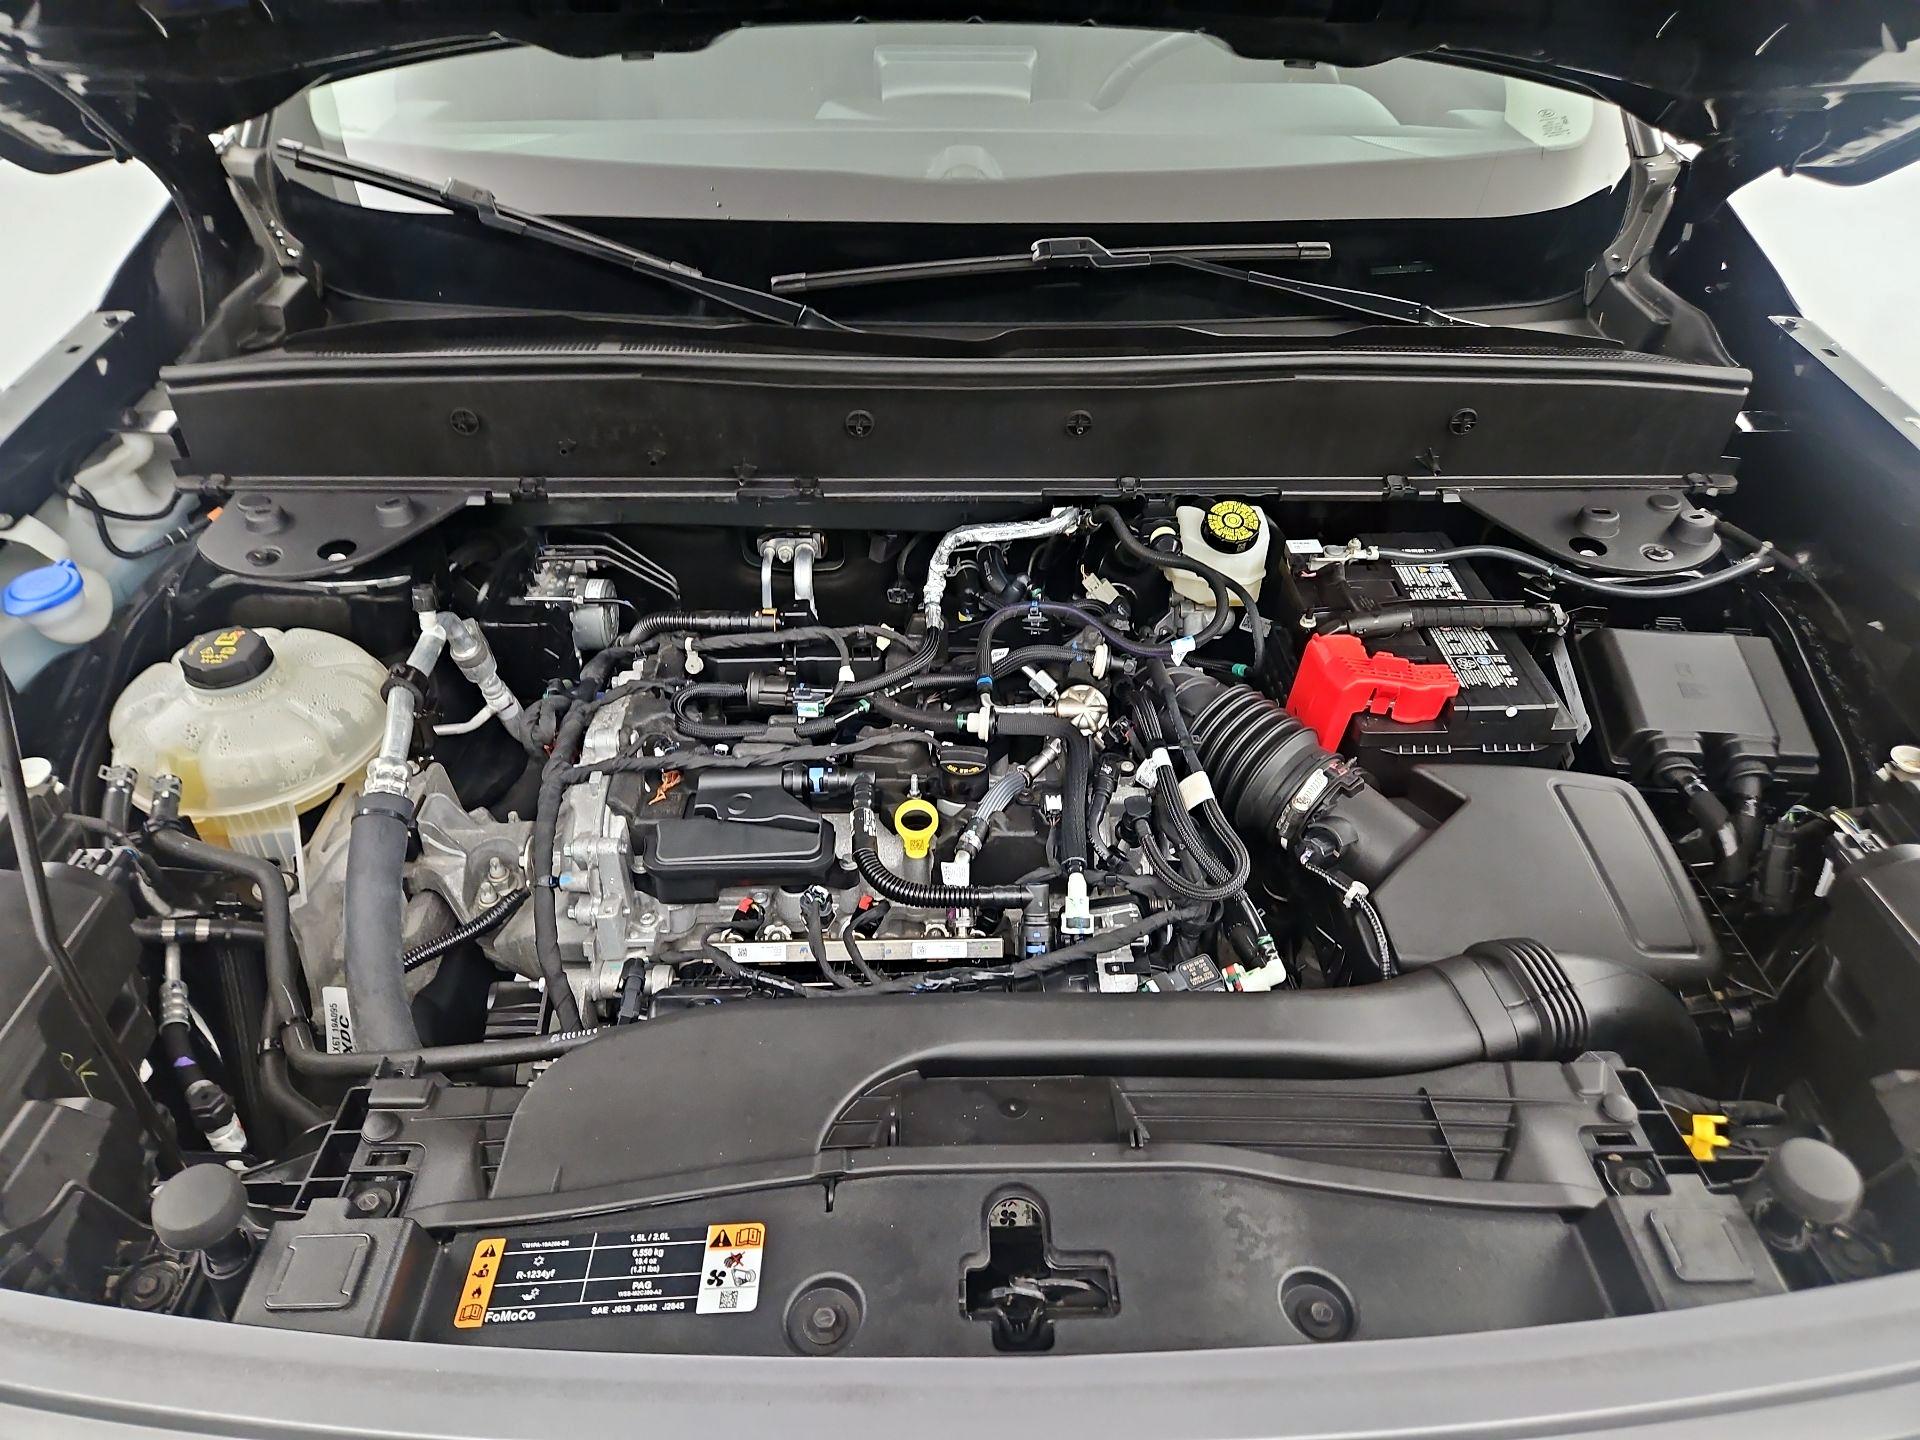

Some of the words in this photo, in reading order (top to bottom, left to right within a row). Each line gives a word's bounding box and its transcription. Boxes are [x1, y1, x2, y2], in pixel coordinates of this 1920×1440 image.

[340, 1015, 353, 1053] XDC
[653, 1248, 665, 1258] kg
[515, 1268, 556, 1280] R-1234yf
[631, 1281, 653, 1290] PAG
[484, 1309, 537, 1323] FoMoCo
[591, 1306, 610, 1315] SAE
